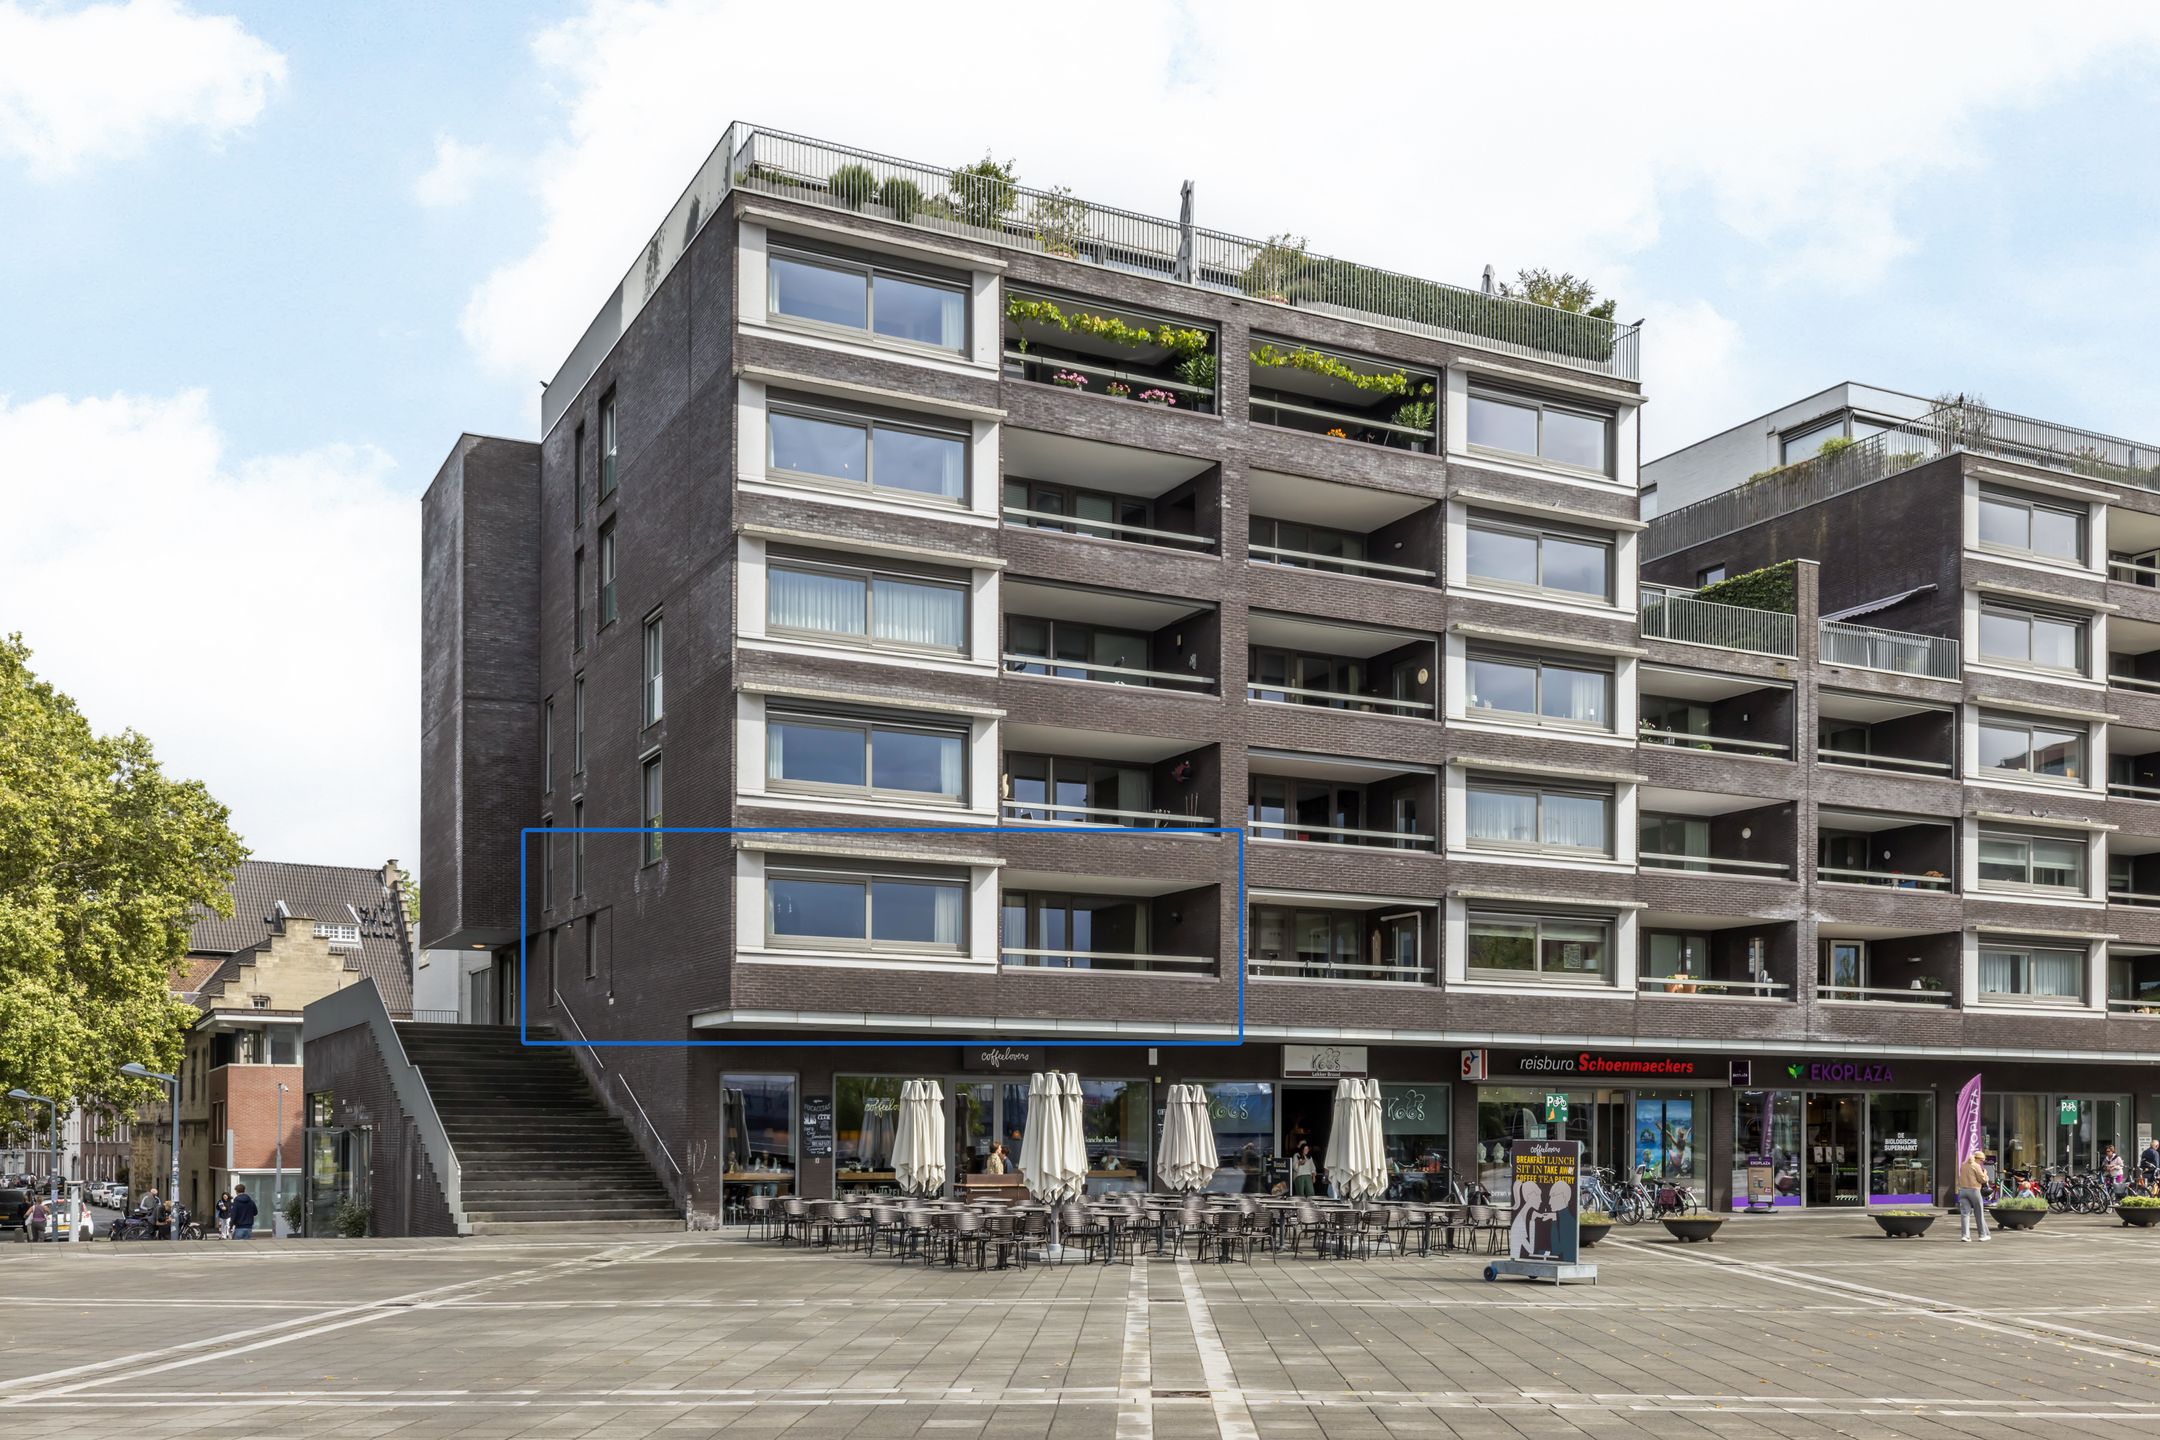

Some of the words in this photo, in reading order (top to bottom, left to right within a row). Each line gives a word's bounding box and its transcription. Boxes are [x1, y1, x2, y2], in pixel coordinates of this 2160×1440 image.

[981, 1047, 1030, 1067] coffeelovers
[1520, 1055, 1574, 1071] reisburo
[1579, 1052, 1694, 1073] Schoenmaeckers
[1810, 1063, 1893, 1082] EKOPLAZA
[864, 1098, 901, 1118] coffeelo
[1547, 1095, 1554, 1107] P
[2061, 1101, 2067, 1112] P
[1969, 1088, 1980, 1155] KOPLAZA
[1516, 1155, 1546, 1164] BREAKFAST
[1547, 1156, 1575, 1165] LUNCH
[1516, 1165, 1530, 1174] SIT
[1533, 1165, 1543, 1175] IN
[1544, 1166, 1558, 1175] TAKE
[1559, 1166, 1575, 1175] AWAY
[1516, 1175, 1537, 1183] COFFEE
[1538, 1175, 1554, 1184] TEA
[1554, 1176, 1575, 1184] PASTRY
